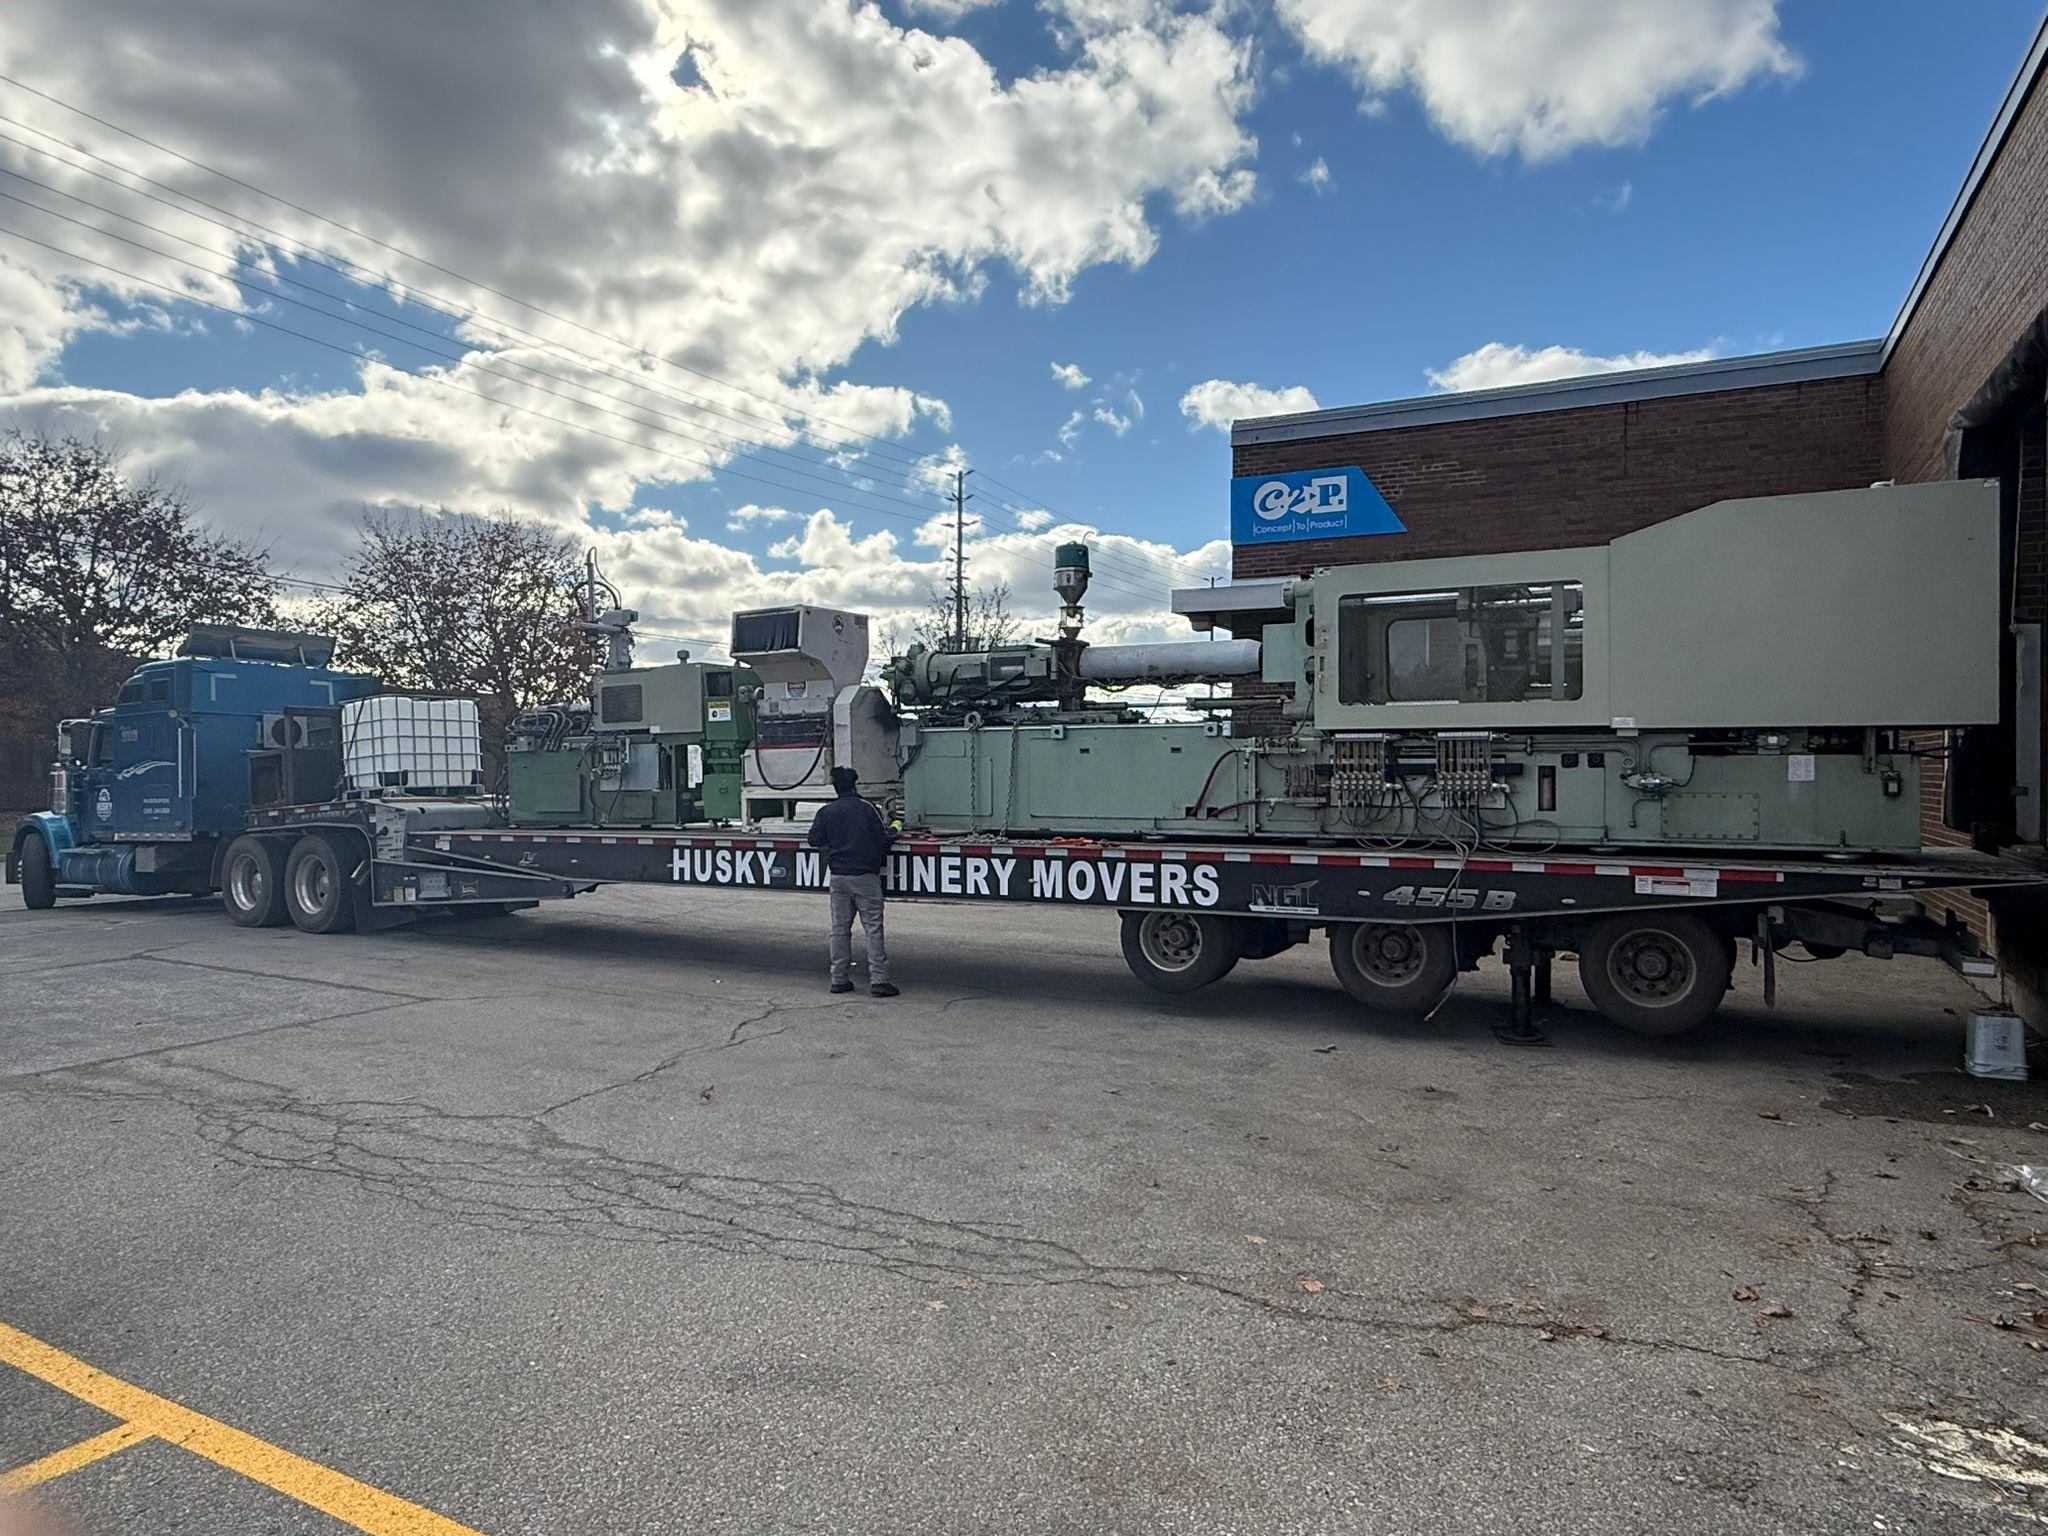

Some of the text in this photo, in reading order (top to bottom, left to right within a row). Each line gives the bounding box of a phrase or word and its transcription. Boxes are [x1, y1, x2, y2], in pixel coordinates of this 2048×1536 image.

[1255, 518, 1344, 534] Concept To Product
[673, 849, 1220, 906] HUSKY MHINERY MOVERS
[1383, 886, 1516, 911] 455 B
